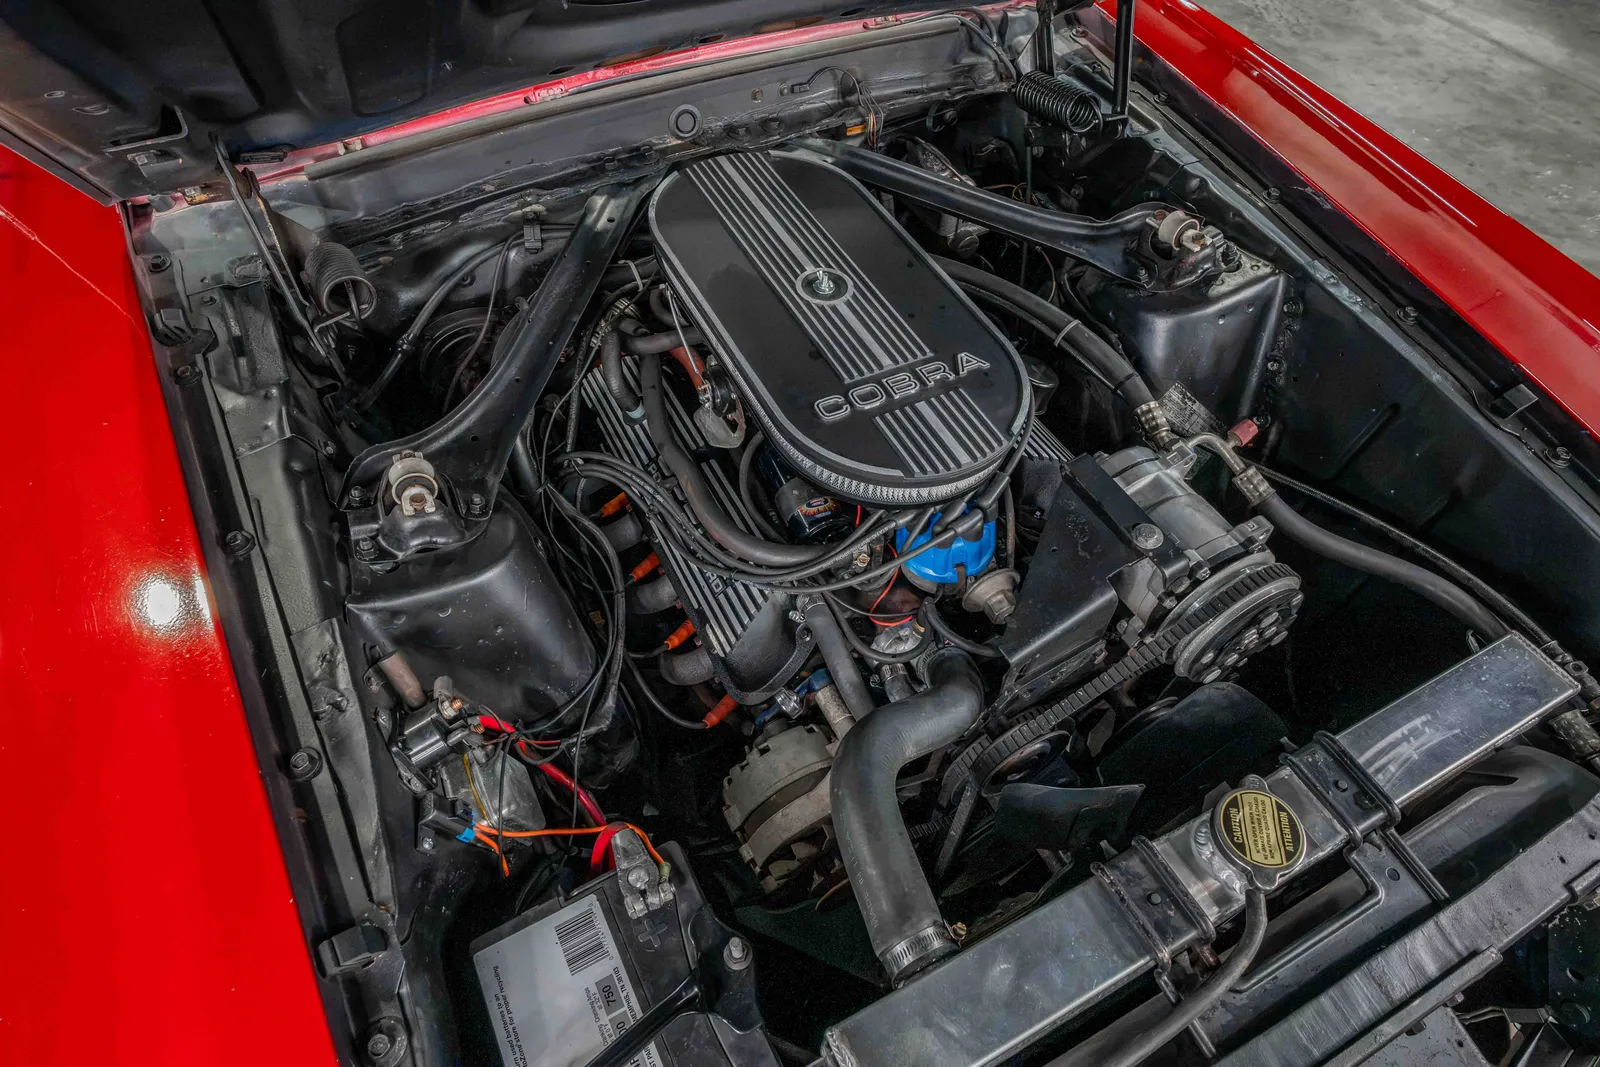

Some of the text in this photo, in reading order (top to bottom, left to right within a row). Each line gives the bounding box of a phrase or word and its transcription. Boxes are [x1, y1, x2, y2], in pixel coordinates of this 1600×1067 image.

[814, 352, 990, 421] COBRA
[1229, 807, 1242, 843] CAUTION
[1279, 811, 1294, 852] ATTENTION
[493, 966, 504, 993] recycling
[502, 994, 512, 1015] proper
[602, 984, 616, 1006] 750
[613, 966, 638, 1022] MEMPHIS, TN 38103
[590, 1002, 600, 1023] Cranking
[500, 1010, 512, 1039] batteries
[512, 1026, 520, 1043] store
[598, 1024, 608, 1046] Cranking
[616, 1021, 627, 1034] 00
[508, 1040, 517, 1056] used
